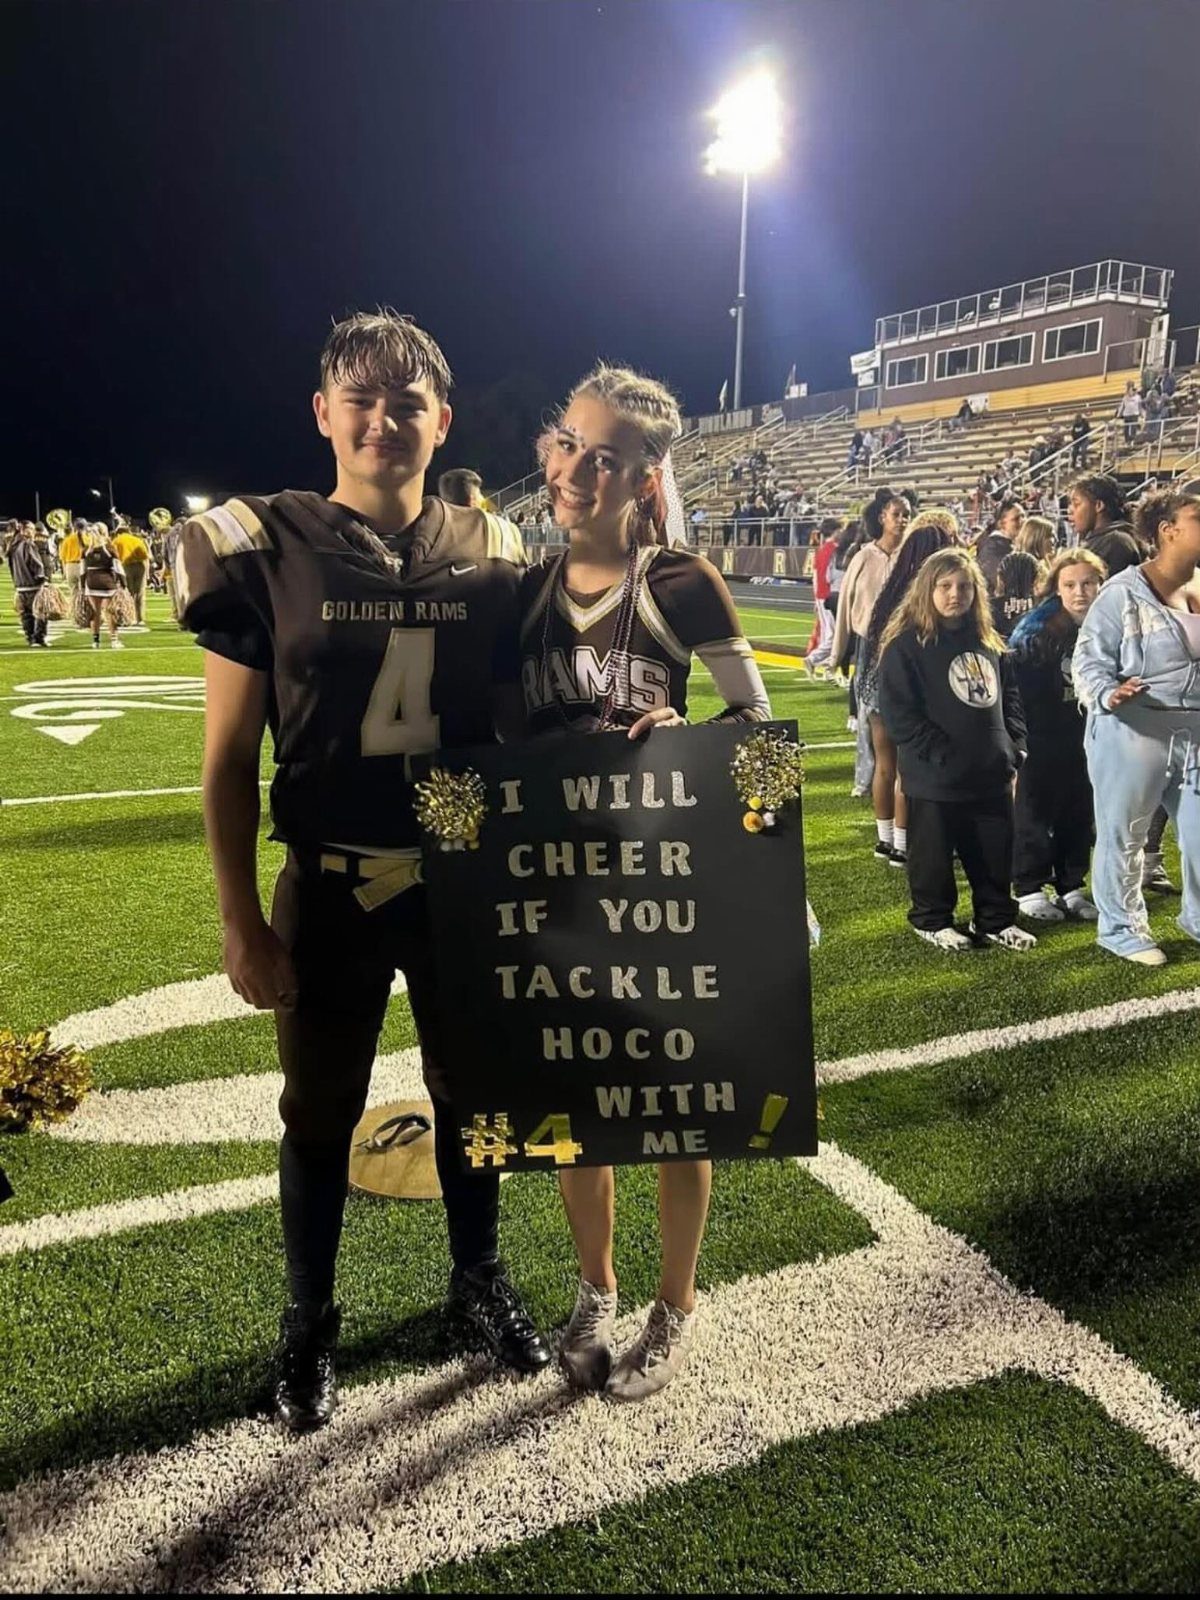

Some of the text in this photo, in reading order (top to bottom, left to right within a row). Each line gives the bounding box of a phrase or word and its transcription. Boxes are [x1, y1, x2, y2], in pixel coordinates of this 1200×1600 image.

[321, 601, 468, 621] GOLDEN RAMS
[361, 627, 441, 757] 4
[521, 645, 671, 716] RAMS
[500, 771, 698, 814] I WILL
[507, 840, 692, 877] CHEER
[496, 899, 696, 936] IF YOU
[495, 965, 719, 1000] TACKLE
[542, 1026, 695, 1060] HOCO
[596, 1081, 736, 1118] WITH
[461, 1112, 583, 1168] #4
[642, 1129, 709, 1155] ME
